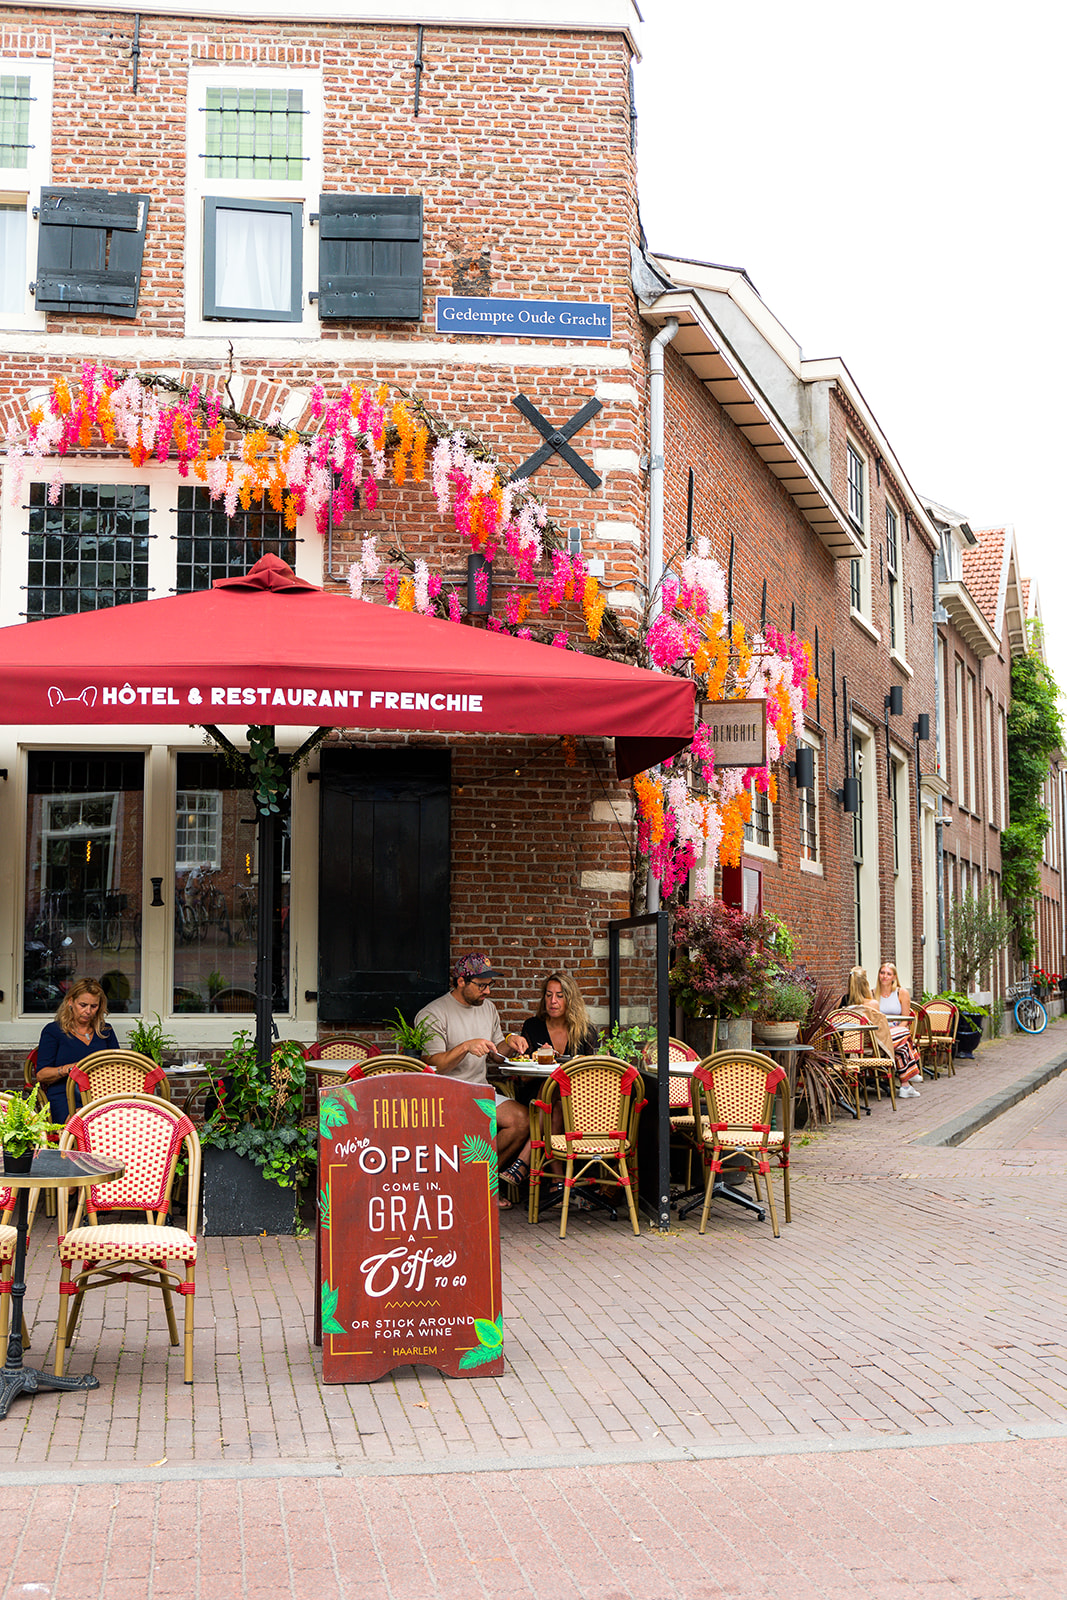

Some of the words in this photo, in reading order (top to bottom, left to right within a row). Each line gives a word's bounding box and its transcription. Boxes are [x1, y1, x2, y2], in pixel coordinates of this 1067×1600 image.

[442, 307, 515, 327] Gedempte
[518, 310, 556, 325] Oude
[559, 312, 608, 327] Gracht
[102, 682, 180, 706] HÔTEL
[187, 688, 203, 705] &
[210, 688, 364, 708] RESTAURANT
[370, 691, 483, 713] FRENCHIE
[373, 1098, 445, 1129] FRENCHIE
[335, 1137, 370, 1158] We're
[359, 1144, 460, 1175] OPEN
[382, 1182, 420, 1192] COME
[368, 1194, 454, 1232] GRAB
[407, 1234, 416, 1242] A
[359, 1246, 457, 1298] Coffee
[435, 1276, 448, 1288] TO
[452, 1275, 467, 1287] GO
[351, 1320, 370, 1329] OR
[375, 1318, 415, 1328] STICK
[419, 1316, 475, 1326] AROUND
[374, 1330, 401, 1339] FOR
[405, 1330, 415, 1338] A
[418, 1328, 453, 1336] WINE
[392, 1346, 438, 1357] HAARLEM
